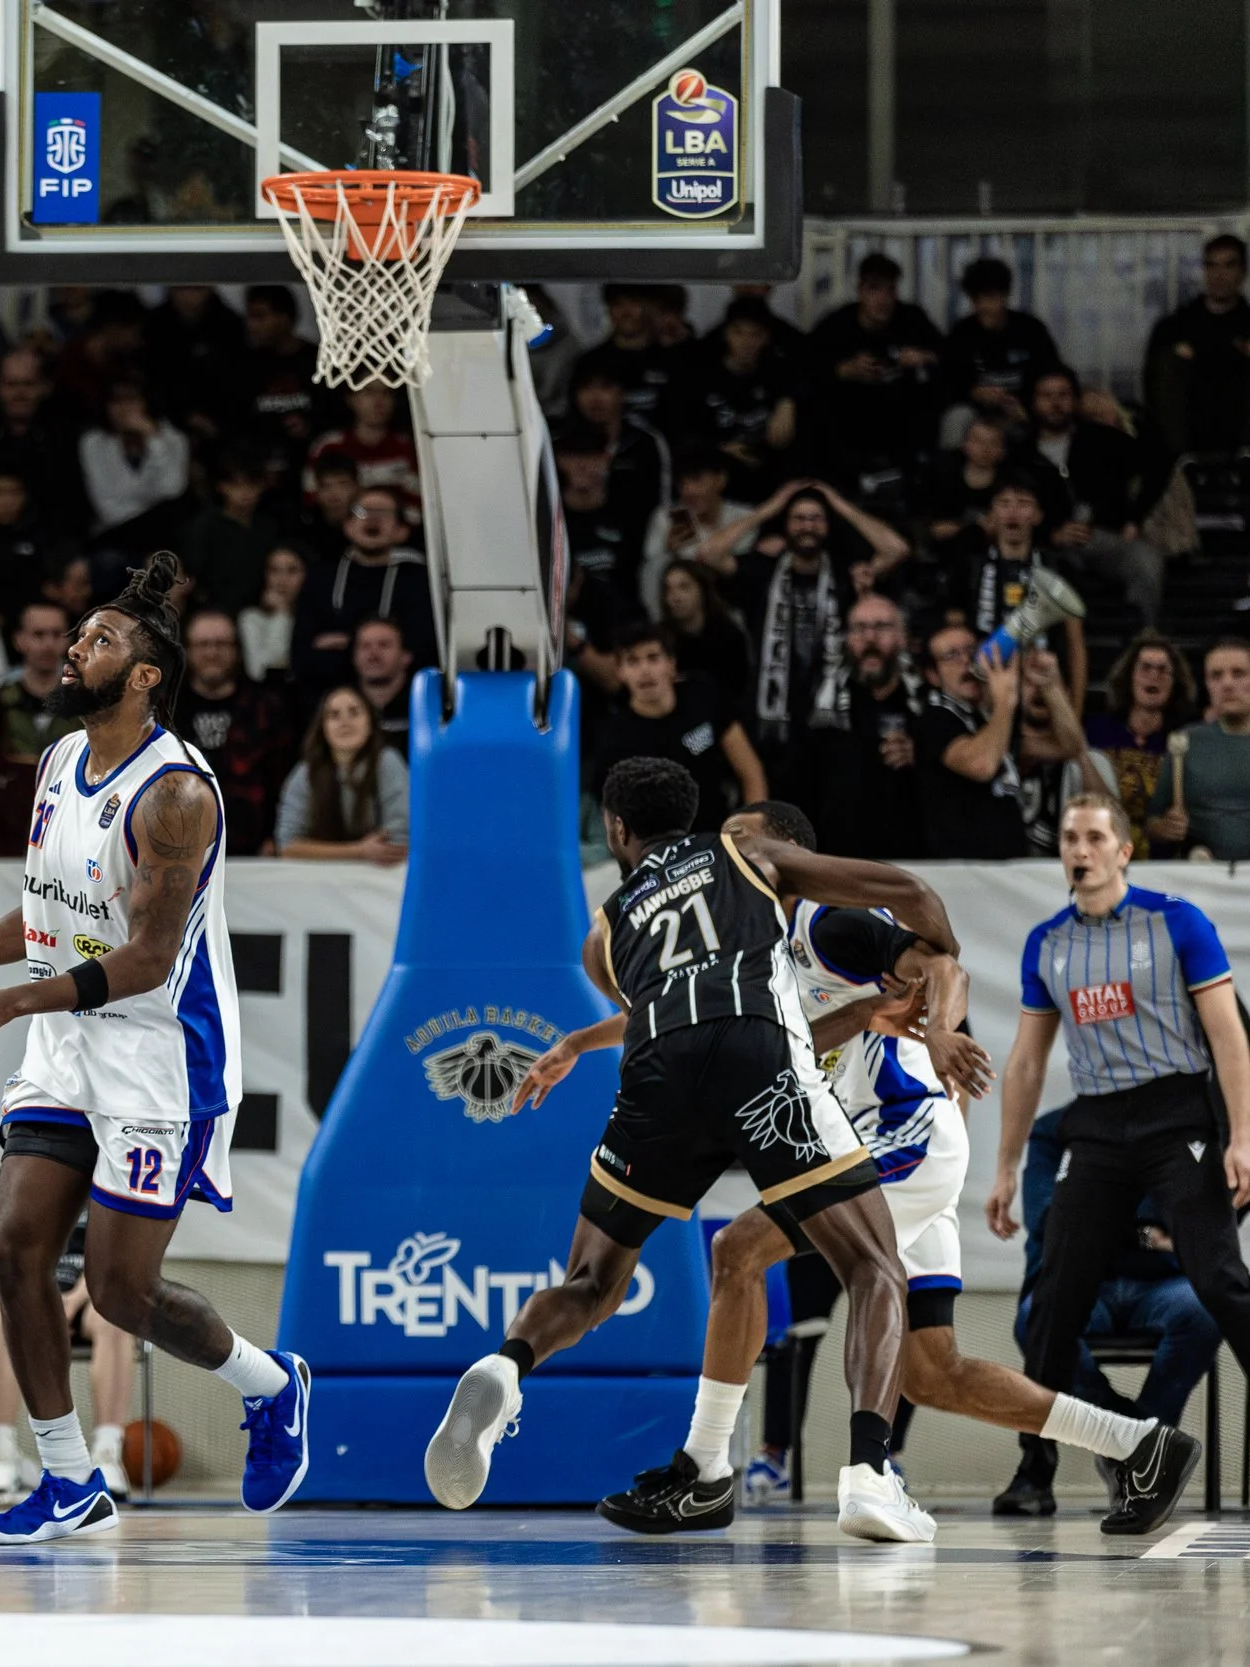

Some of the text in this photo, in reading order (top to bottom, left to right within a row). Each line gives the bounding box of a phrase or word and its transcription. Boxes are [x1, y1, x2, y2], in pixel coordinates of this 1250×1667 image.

[665, 129, 728, 154] LBA
[676, 157, 716, 167] SERIE A
[39, 178, 93, 198] FIP
[670, 178, 713, 203] Unipol
[628, 867, 715, 931] MAWUGBE
[650, 891, 721, 973] 21
[1077, 984, 1126, 1008] ATTAL
[1078, 1000, 1128, 1018] GROUP
[405, 1006, 480, 1054] AQUILA
[125, 1146, 164, 1195] 12
[323, 1252, 656, 1337] TRENTO
